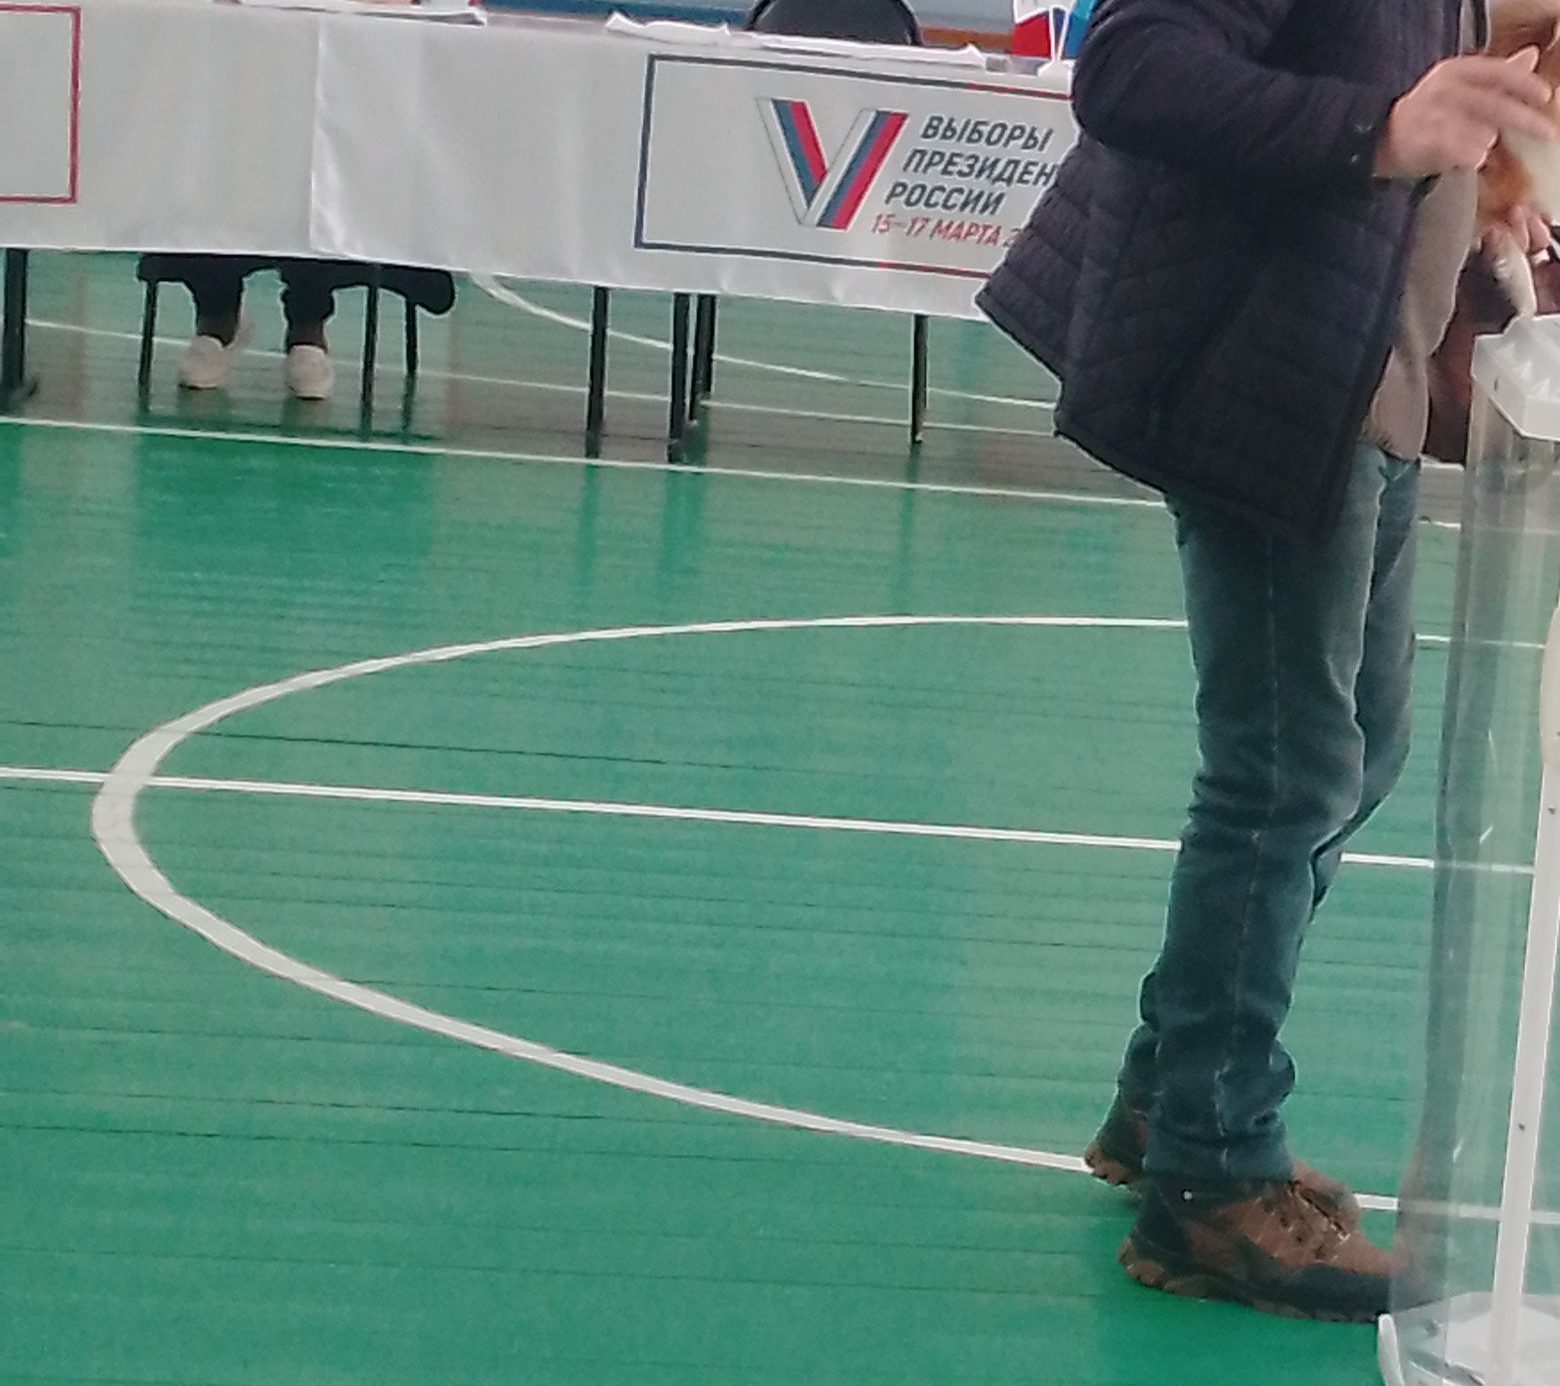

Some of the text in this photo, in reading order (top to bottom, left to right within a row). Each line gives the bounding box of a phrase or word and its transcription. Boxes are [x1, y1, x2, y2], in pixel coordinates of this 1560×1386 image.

[922, 114, 1053, 152] ВЫБОРЫ
[902, 148, 1058, 187] ПРЕЗИДЕН
[885, 179, 1006, 215] РОССИИ
[929, 217, 1002, 247] МАРТА
